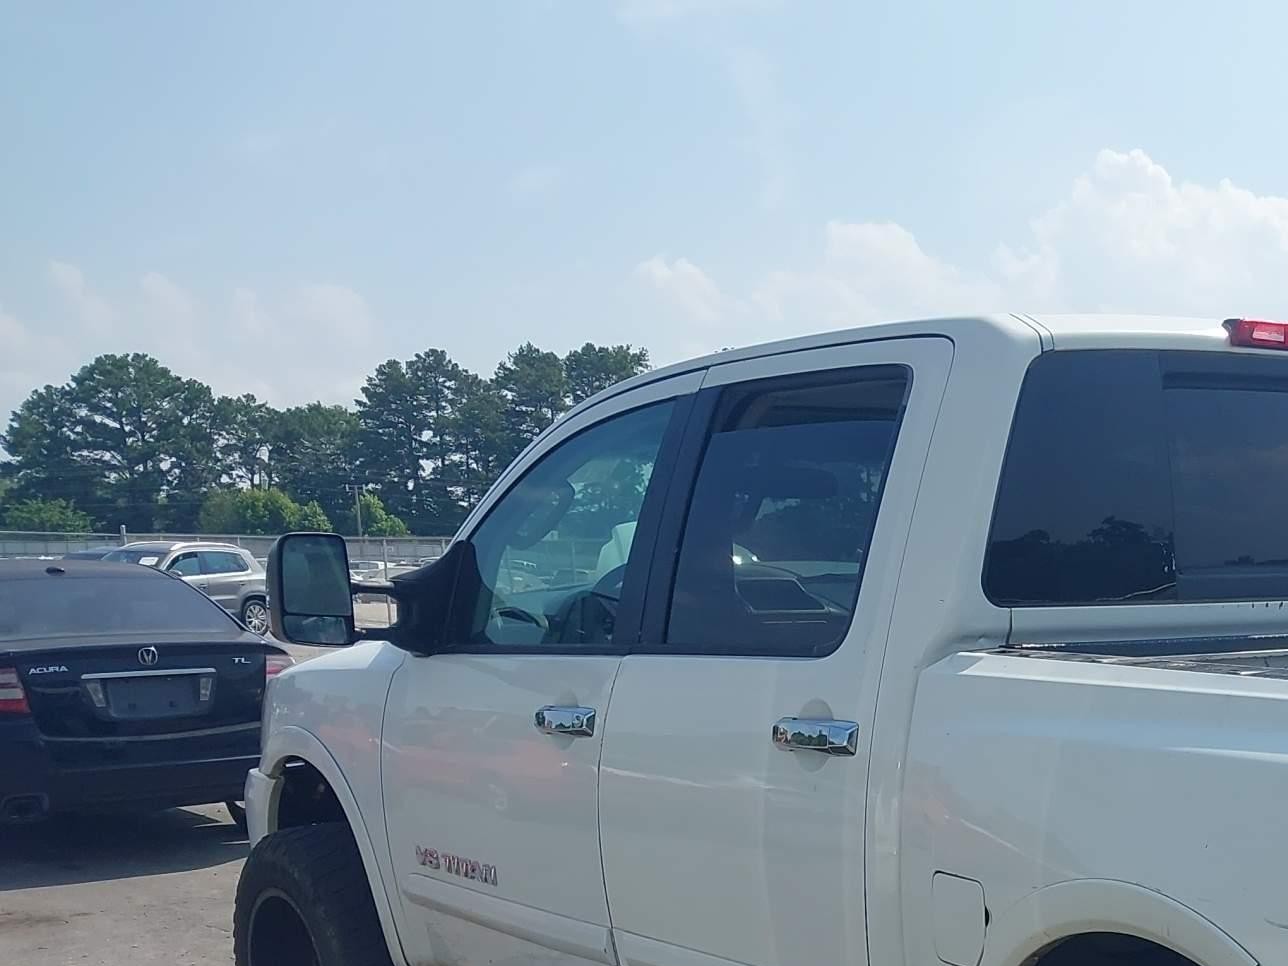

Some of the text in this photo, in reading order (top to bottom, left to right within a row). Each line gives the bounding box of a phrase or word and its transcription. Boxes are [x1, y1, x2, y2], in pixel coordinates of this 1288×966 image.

[29, 665, 69, 675] ACURA
[416, 845, 498, 887] V8 TITAN
